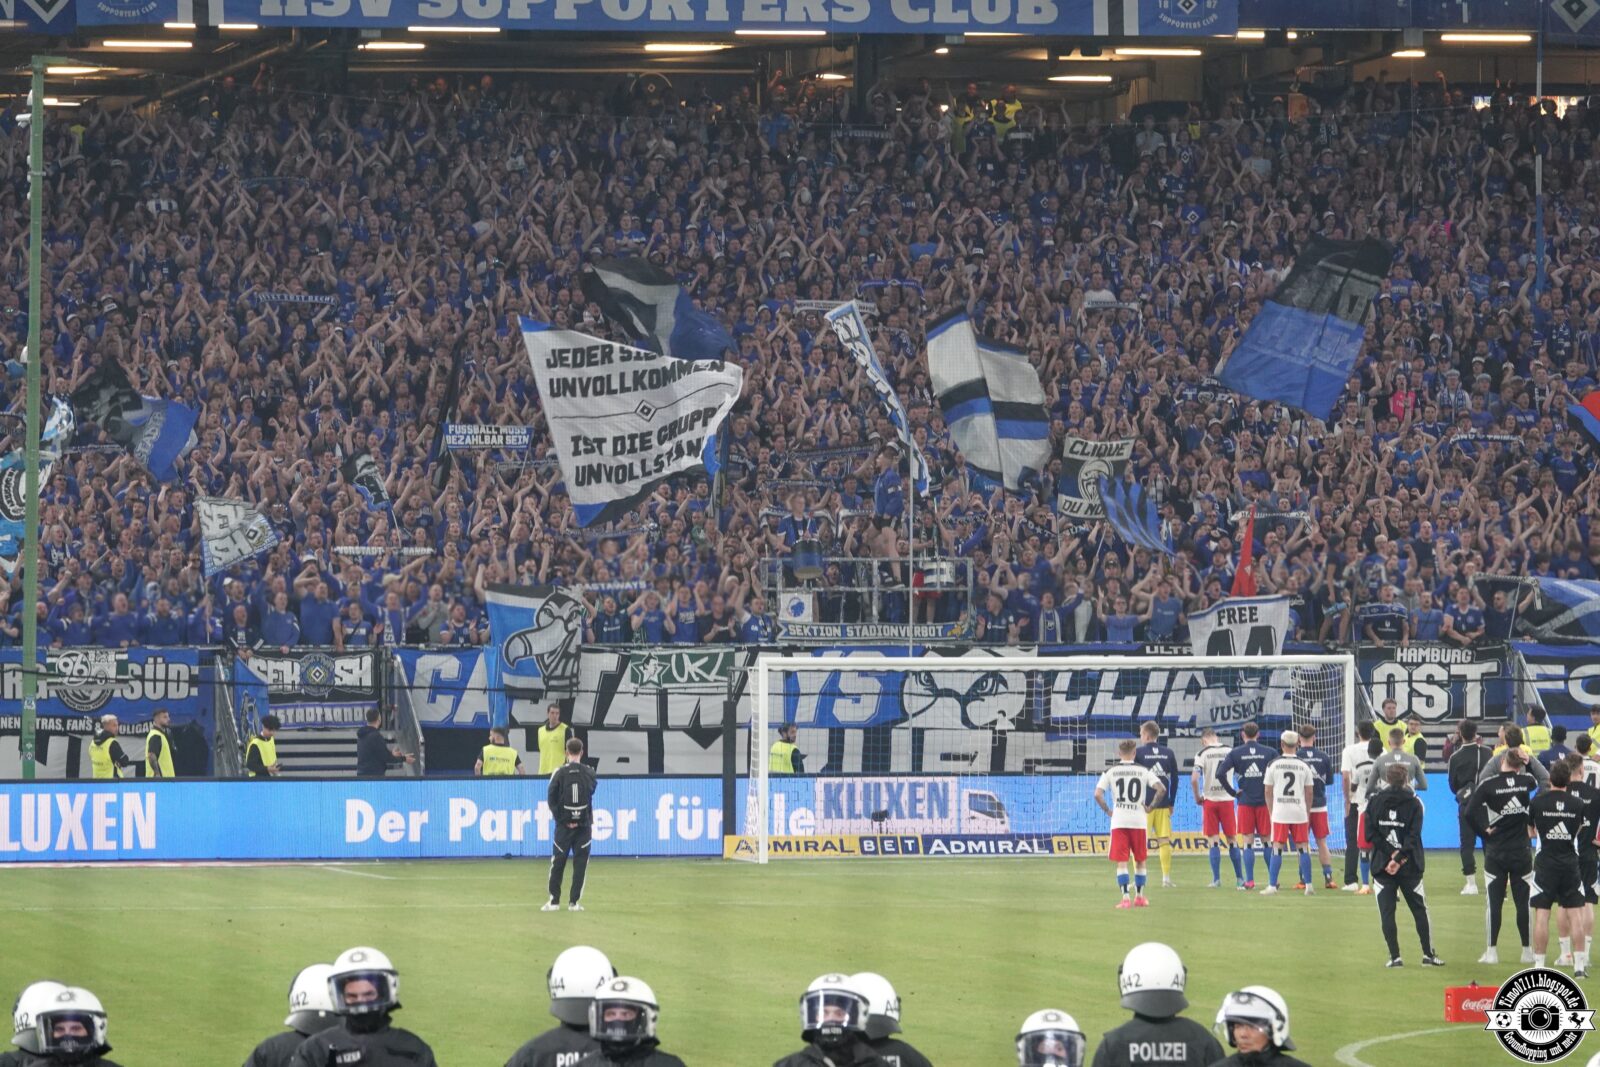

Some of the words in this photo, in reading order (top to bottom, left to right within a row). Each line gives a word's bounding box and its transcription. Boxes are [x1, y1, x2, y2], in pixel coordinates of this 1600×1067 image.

[1158, 13, 1201, 29] SUPPORTERS
[546, 344, 614, 369] JEDER
[448, 424, 498, 435] FUSSBALL
[500, 425, 527, 435] MUSS
[446, 434, 504, 446] BEZAHLBAR
[505, 434, 530, 445] SEIN
[570, 434, 607, 457] IST
[612, 431, 653, 457] DIE
[1069, 440, 1130, 458] CLIQUE
[574, 439, 704, 487] UNVOLLSTÄN
[1062, 499, 1082, 514] DU
[1217, 606, 1259, 627] FREE
[787, 624, 842, 637] SEKTION
[846, 624, 944, 638] STADIONVERBOT
[1145, 645, 1192, 655] ULTR
[1396, 647, 1473, 664] HAMBURG
[1372, 661, 1499, 719] OST
[66, 719, 93, 732] FANS
[1115, 777, 1142, 803] 10
[1283, 771, 1296, 796] 2
[1495, 786, 1528, 794] HanseMerkur
[823, 782, 950, 820] KLUXEN
[345, 798, 429, 843] Der
[448, 797, 638, 843] Parter
[655, 792, 723, 841] für
[1500, 806, 1526, 816] adidas
[0, 792, 156, 852] LUXEN
[1545, 832, 1572, 841] adidas
[863, 839, 916, 853] BET
[929, 838, 1050, 855] ADMIRAL
[1057, 840, 1108, 852] BET
[1129, 1042, 1187, 1062] POLIZEI
